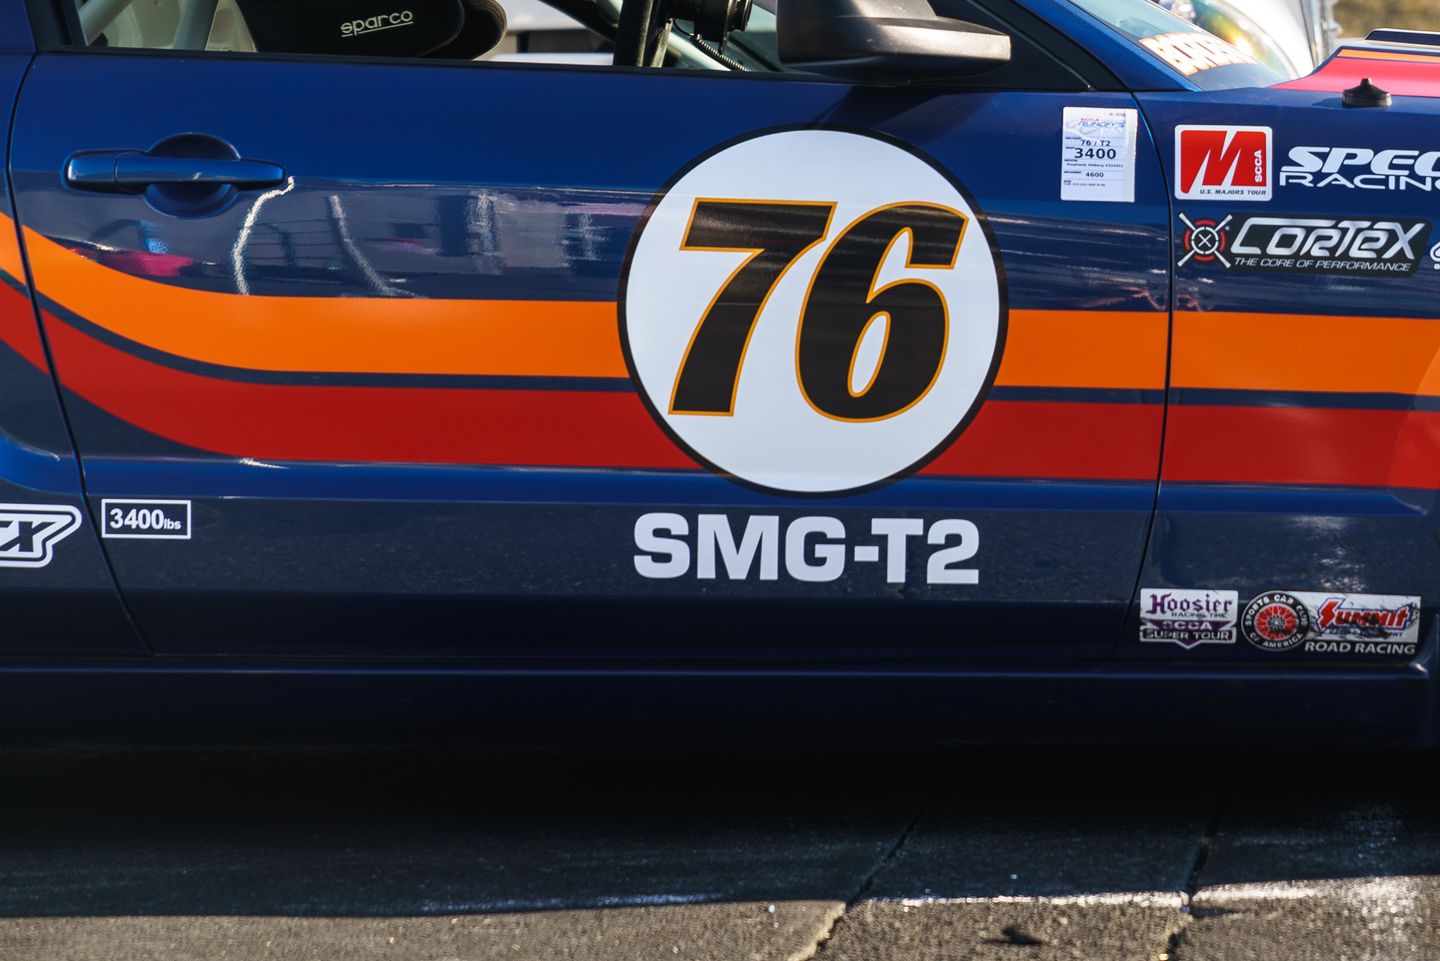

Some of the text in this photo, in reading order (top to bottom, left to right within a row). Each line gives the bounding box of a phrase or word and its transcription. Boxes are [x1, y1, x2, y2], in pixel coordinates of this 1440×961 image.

[340, 10, 414, 36] sparco
[1080, 139, 1092, 147] 76
[1099, 139, 1111, 147] T2
[1074, 147, 1117, 160] 3400
[1253, 149, 1263, 183] SCCA
[1234, 257, 1413, 272] THE CORE OF PERFORMANCE
[668, 197, 970, 424] 76
[109, 508, 183, 530] 3400lbs
[633, 512, 980, 585] SMG-T2
[1145, 592, 1233, 615] Hoosier
[1274, 594, 1294, 605] CAR
[1162, 621, 1214, 630] SCCA
[1145, 629, 1230, 640] SUPER TOUR
[1304, 640, 1417, 656] ROAD RACING
